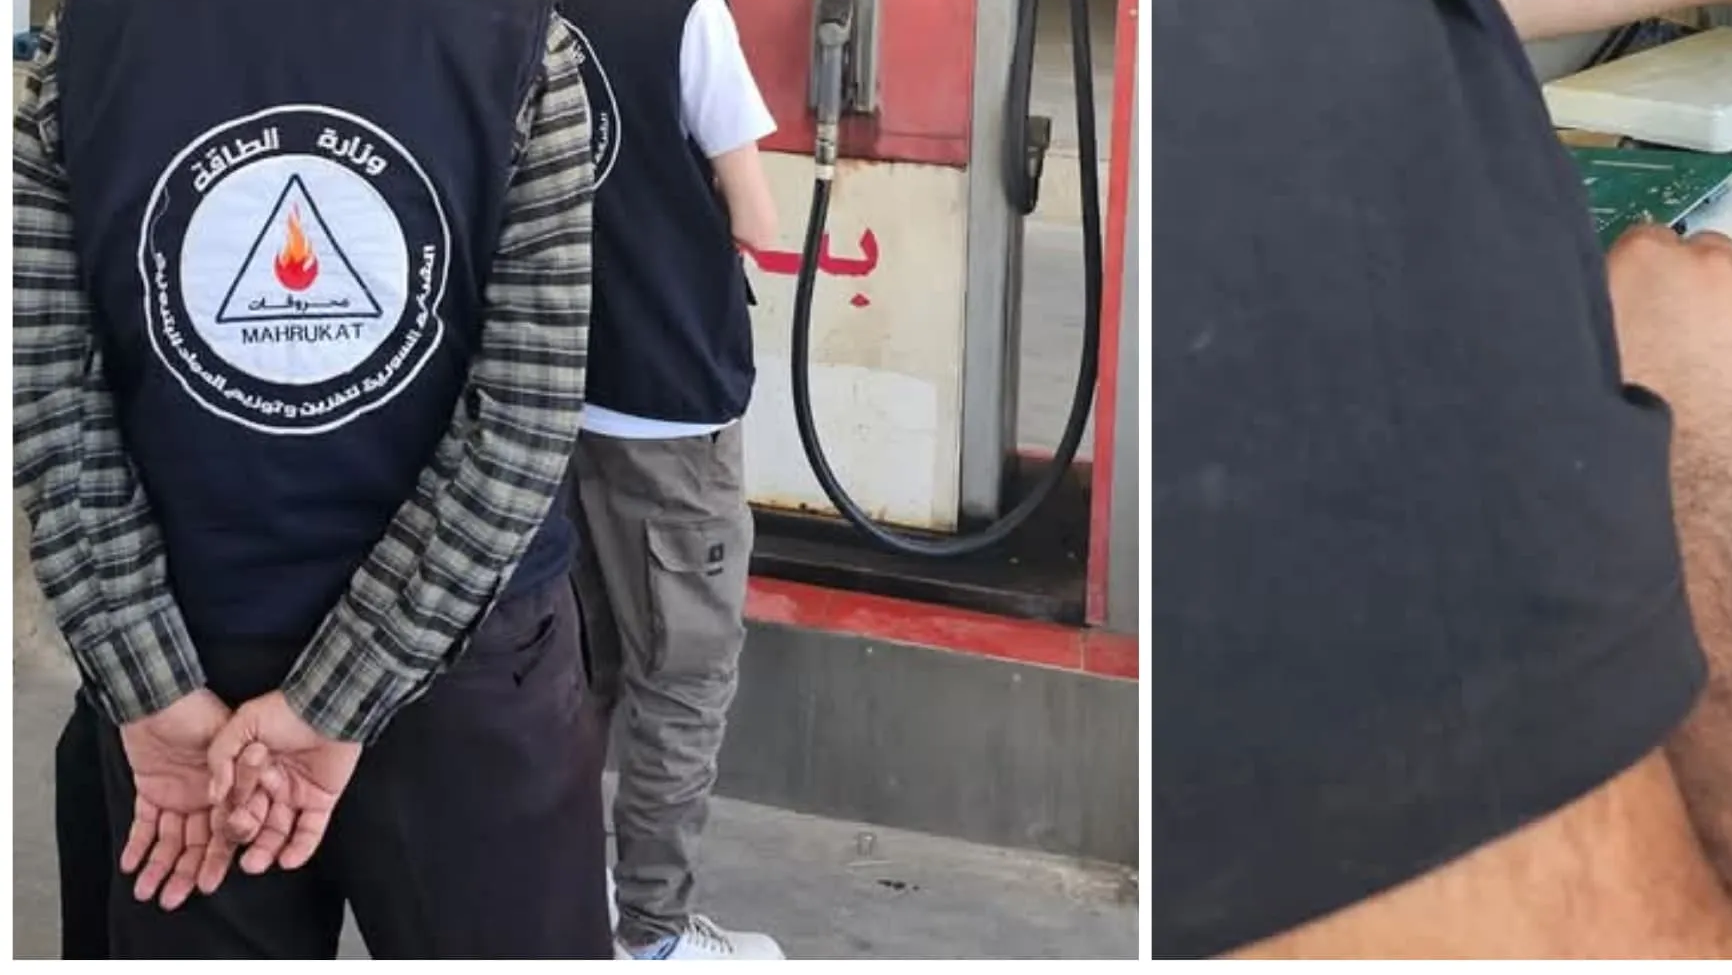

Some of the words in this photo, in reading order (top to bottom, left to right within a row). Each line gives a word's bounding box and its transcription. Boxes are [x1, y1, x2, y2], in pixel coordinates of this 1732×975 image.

[190, 126, 280, 193] الطاقة
[316, 127, 388, 176] وزارة
[241, 322, 364, 345] MAHRUKAT
